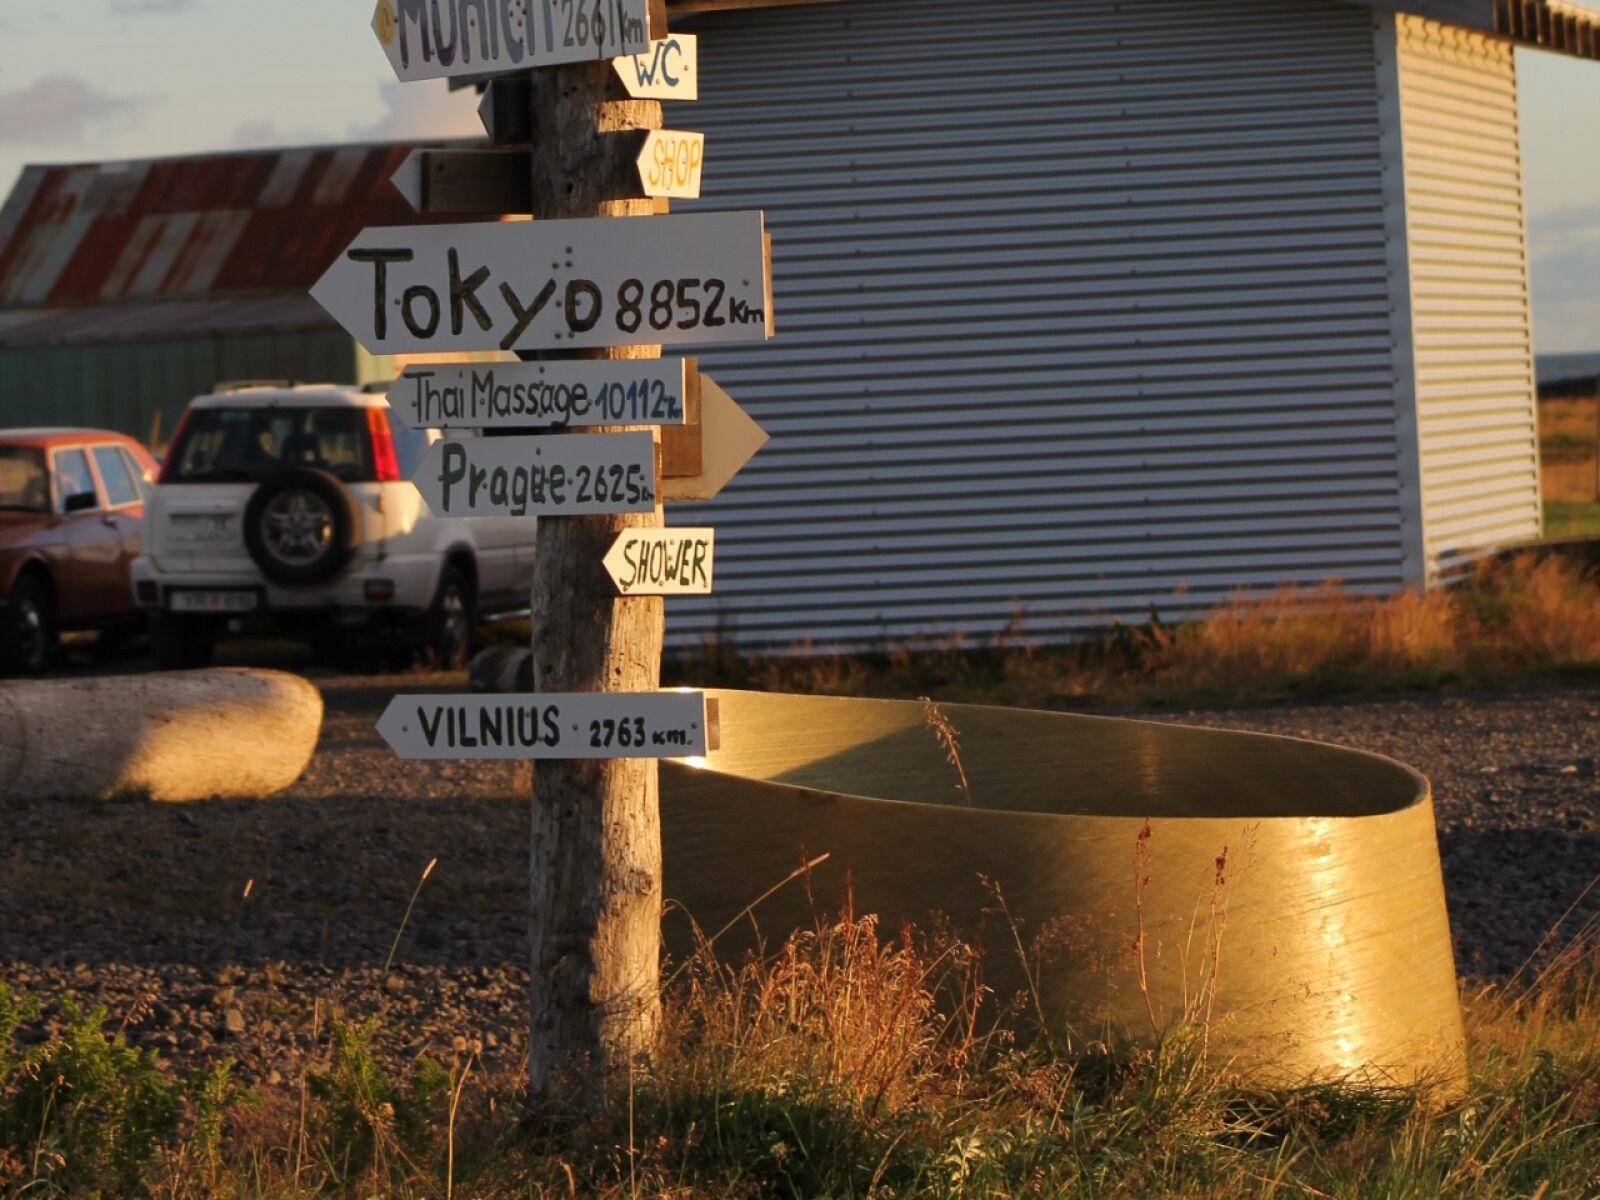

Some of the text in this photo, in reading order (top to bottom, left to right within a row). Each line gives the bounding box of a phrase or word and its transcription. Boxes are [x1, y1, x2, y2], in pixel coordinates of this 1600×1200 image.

[632, 38, 682, 88] WC
[649, 137, 701, 188] SHOP
[615, 277, 726, 334] 8852
[404, 370, 464, 425] Thai
[470, 368, 590, 427] Massage
[441, 442, 570, 516] Prague
[575, 463, 641, 505] 2625
[619, 538, 709, 591] SHOWER
[417, 705, 560, 748] VILNIUS
[589, 716, 646, 748] 2763
